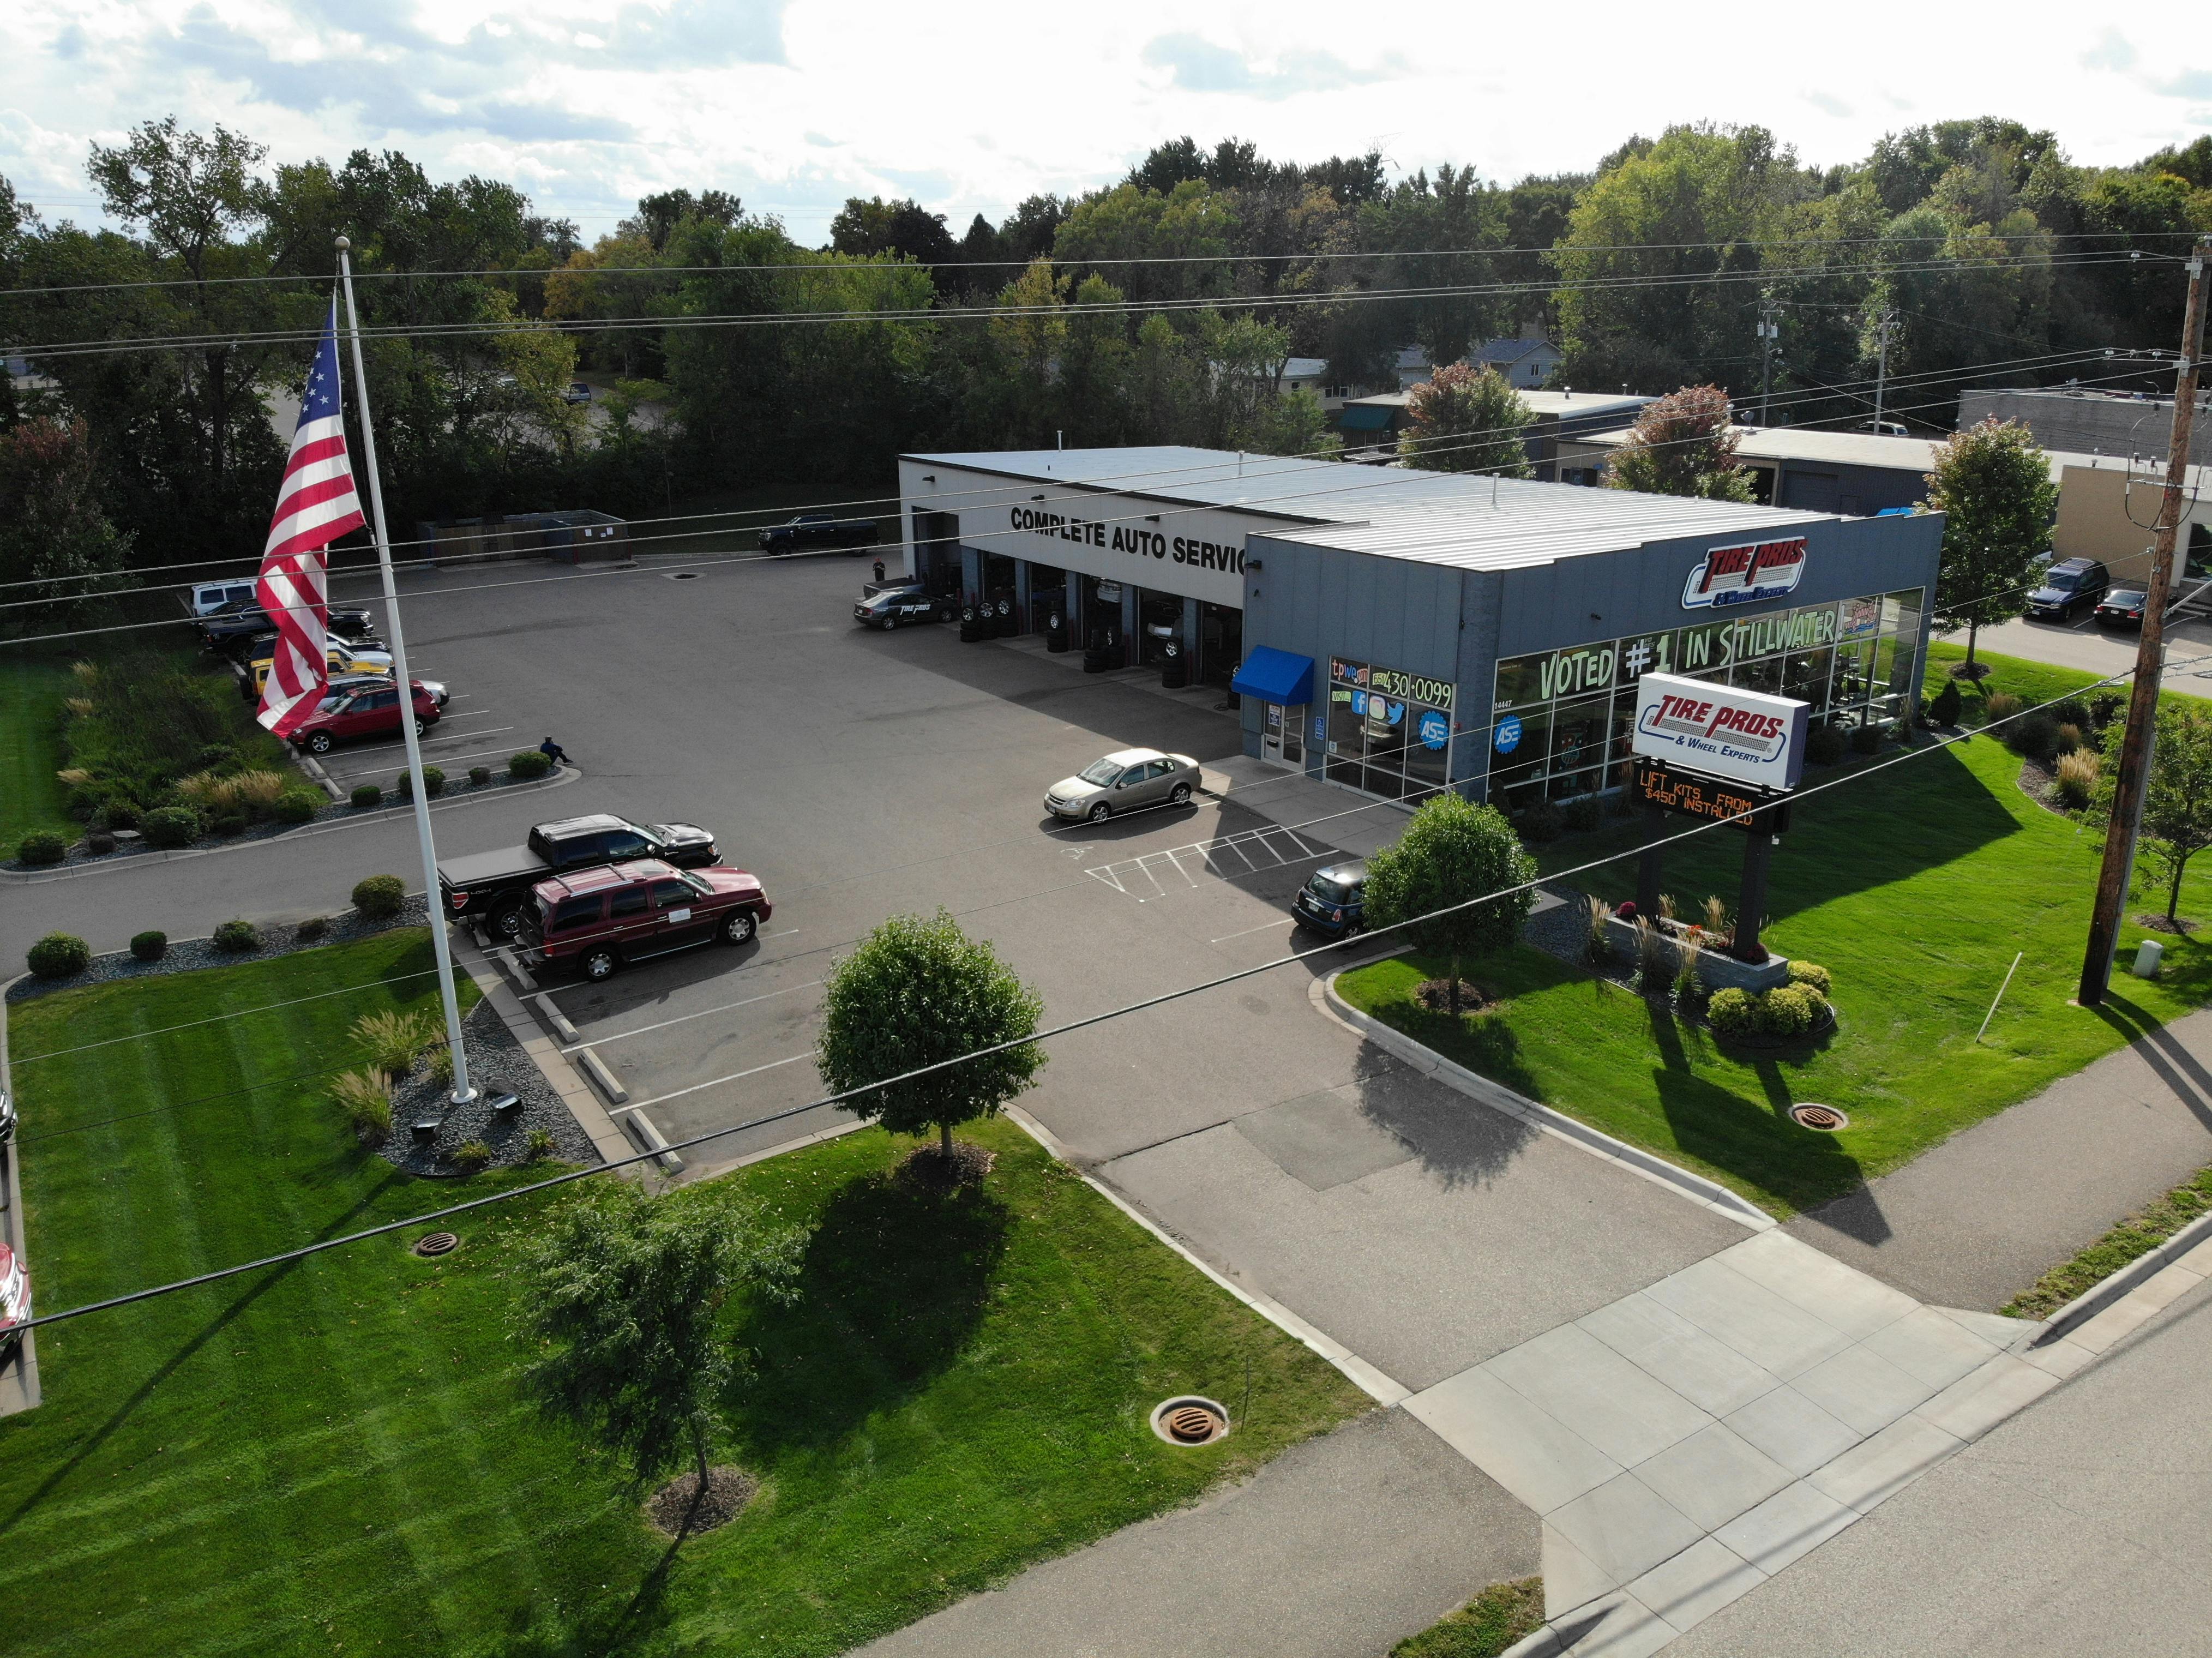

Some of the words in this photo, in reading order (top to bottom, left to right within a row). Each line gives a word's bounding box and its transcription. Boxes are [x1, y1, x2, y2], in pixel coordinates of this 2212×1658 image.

[1011, 507, 1105, 548] COMPLETE
[1111, 526, 1167, 560] AUTO
[1698, 545, 1755, 594] TIRE
[1744, 538, 1809, 587] PROS
[900, 605, 915, 616] TIRE
[1541, 649, 1614, 700] VOTED
[1625, 634, 1671, 678] #1
[1686, 628, 1711, 669] IN
[1494, 700, 1512, 710] 14447
[1651, 694, 1714, 726] TIRE
[1703, 706, 1784, 739] PROS
[1421, 720, 1445, 742] ASE
[1496, 724, 1519, 746] ASE
[1675, 735, 1685, 746] &
[1687, 737, 1717, 754] WHEEL
[1720, 745, 1760, 764] EXPERTS
[1640, 769, 1667, 791] LIFT
[1674, 782, 1701, 800] KITS
[1717, 793, 1753, 812] FROM
[1645, 787, 1677, 806] $450
